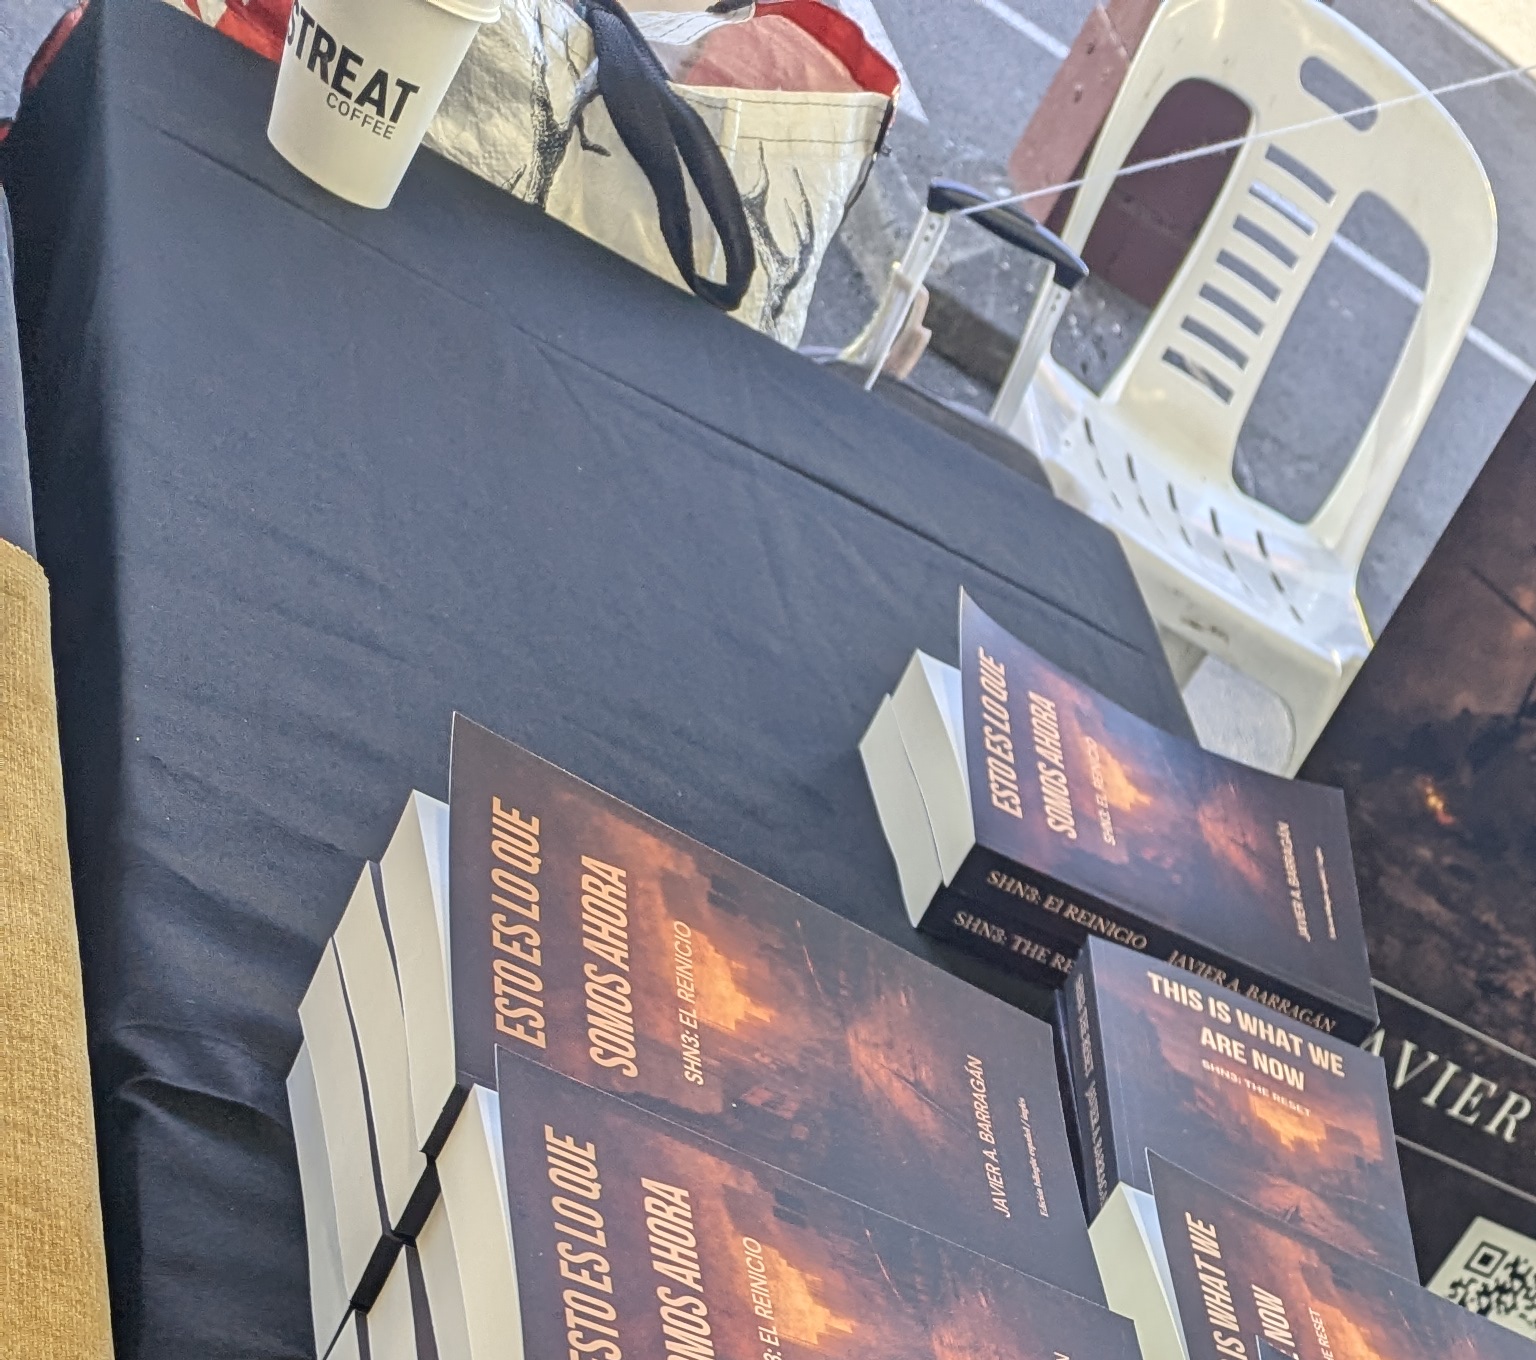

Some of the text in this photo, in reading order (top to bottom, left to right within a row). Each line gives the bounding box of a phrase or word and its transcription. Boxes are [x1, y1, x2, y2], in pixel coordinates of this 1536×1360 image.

[287, 0, 420, 123] STREAT
[326, 92, 396, 140] COFFEE
[978, 646, 1023, 819] ESTO ES LO QUE
[491, 796, 547, 1049] ESTO ES LO QUE
[580, 855, 638, 1078] SOMOS AHORA
[673, 920, 704, 1086] SHN3: EL REINICIO
[1147, 971, 1346, 1077] THIS IS WHAT WE
[1201, 1027, 1305, 1091] ARE NOW
[1360, 1028, 1532, 1143] AVIER
[544, 1124, 602, 1198] QUE
[551, 1195, 608, 1248] LO
[641, 1177, 704, 1292] AHORA
[556, 1241, 613, 1294] ES
[742, 1236, 773, 1318] REINICIO
[758, 1325, 780, 1347] EL
[1252, 1284, 1296, 1348] NOW
[1309, 1307, 1330, 1349] RESET
